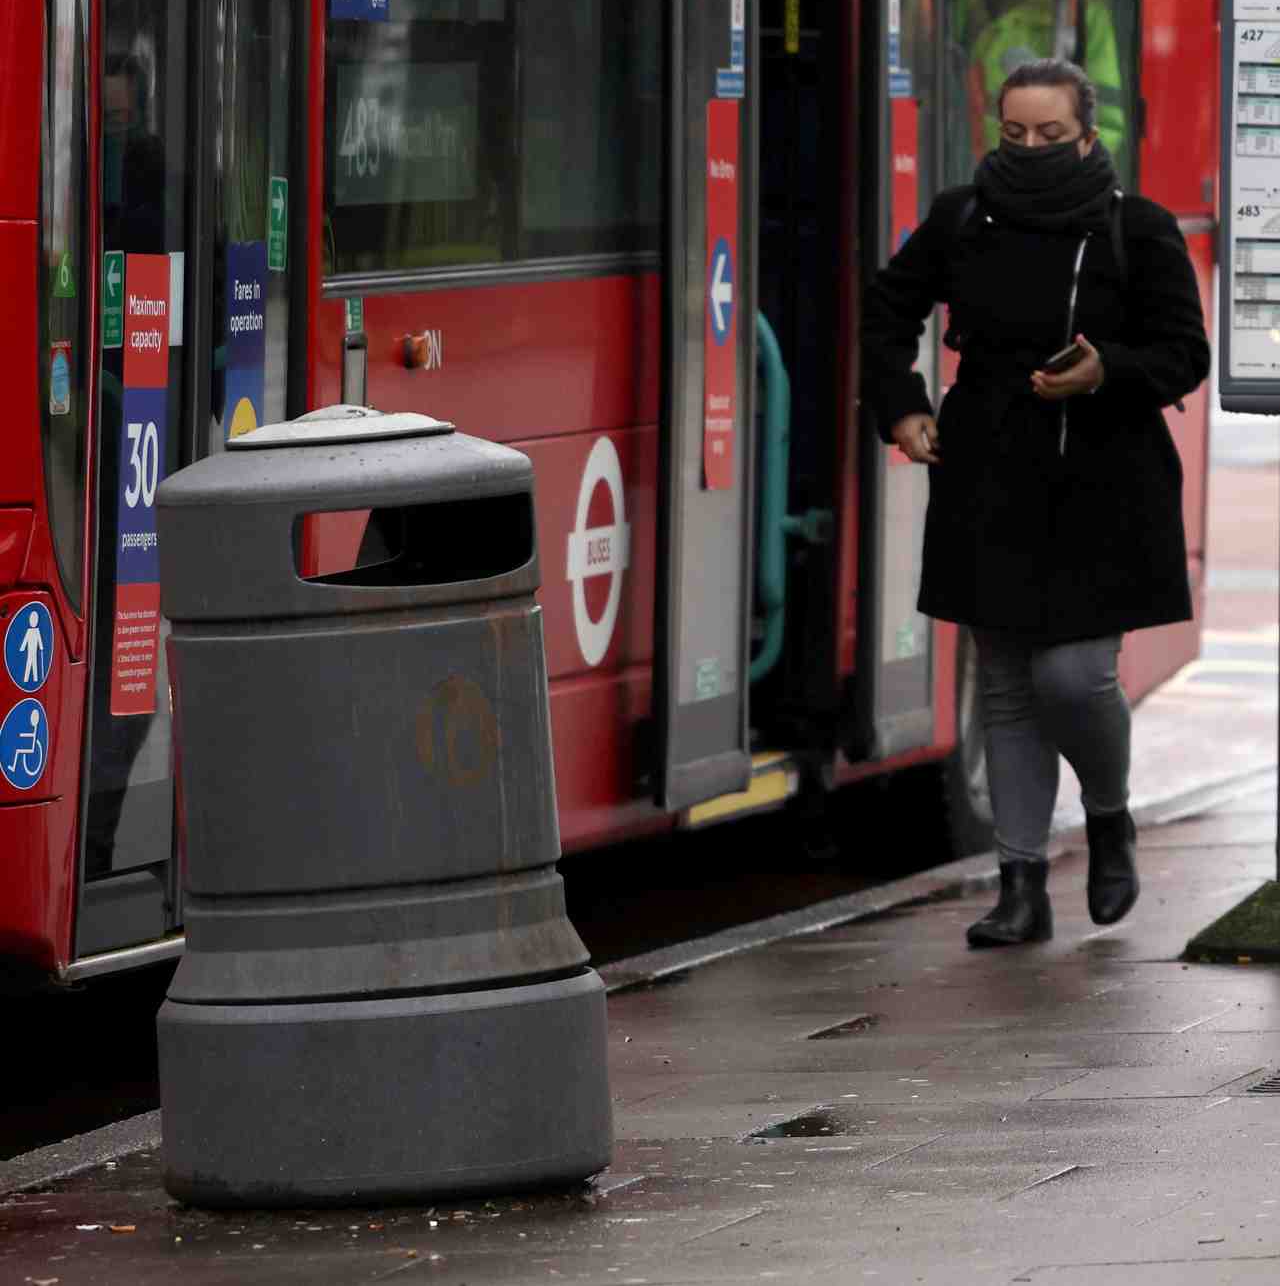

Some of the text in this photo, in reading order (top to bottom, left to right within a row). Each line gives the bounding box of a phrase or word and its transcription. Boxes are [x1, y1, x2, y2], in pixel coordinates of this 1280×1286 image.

[1240, 29, 1264, 41] 427
[1237, 205, 1261, 217] 483
[234, 279, 261, 300] Fares in
[129, 294, 166, 316] Maximum
[230, 310, 264, 338] operation
[131, 327, 162, 353] capacity
[125, 420, 159, 509] 30
[122, 531, 158, 553] passengers
